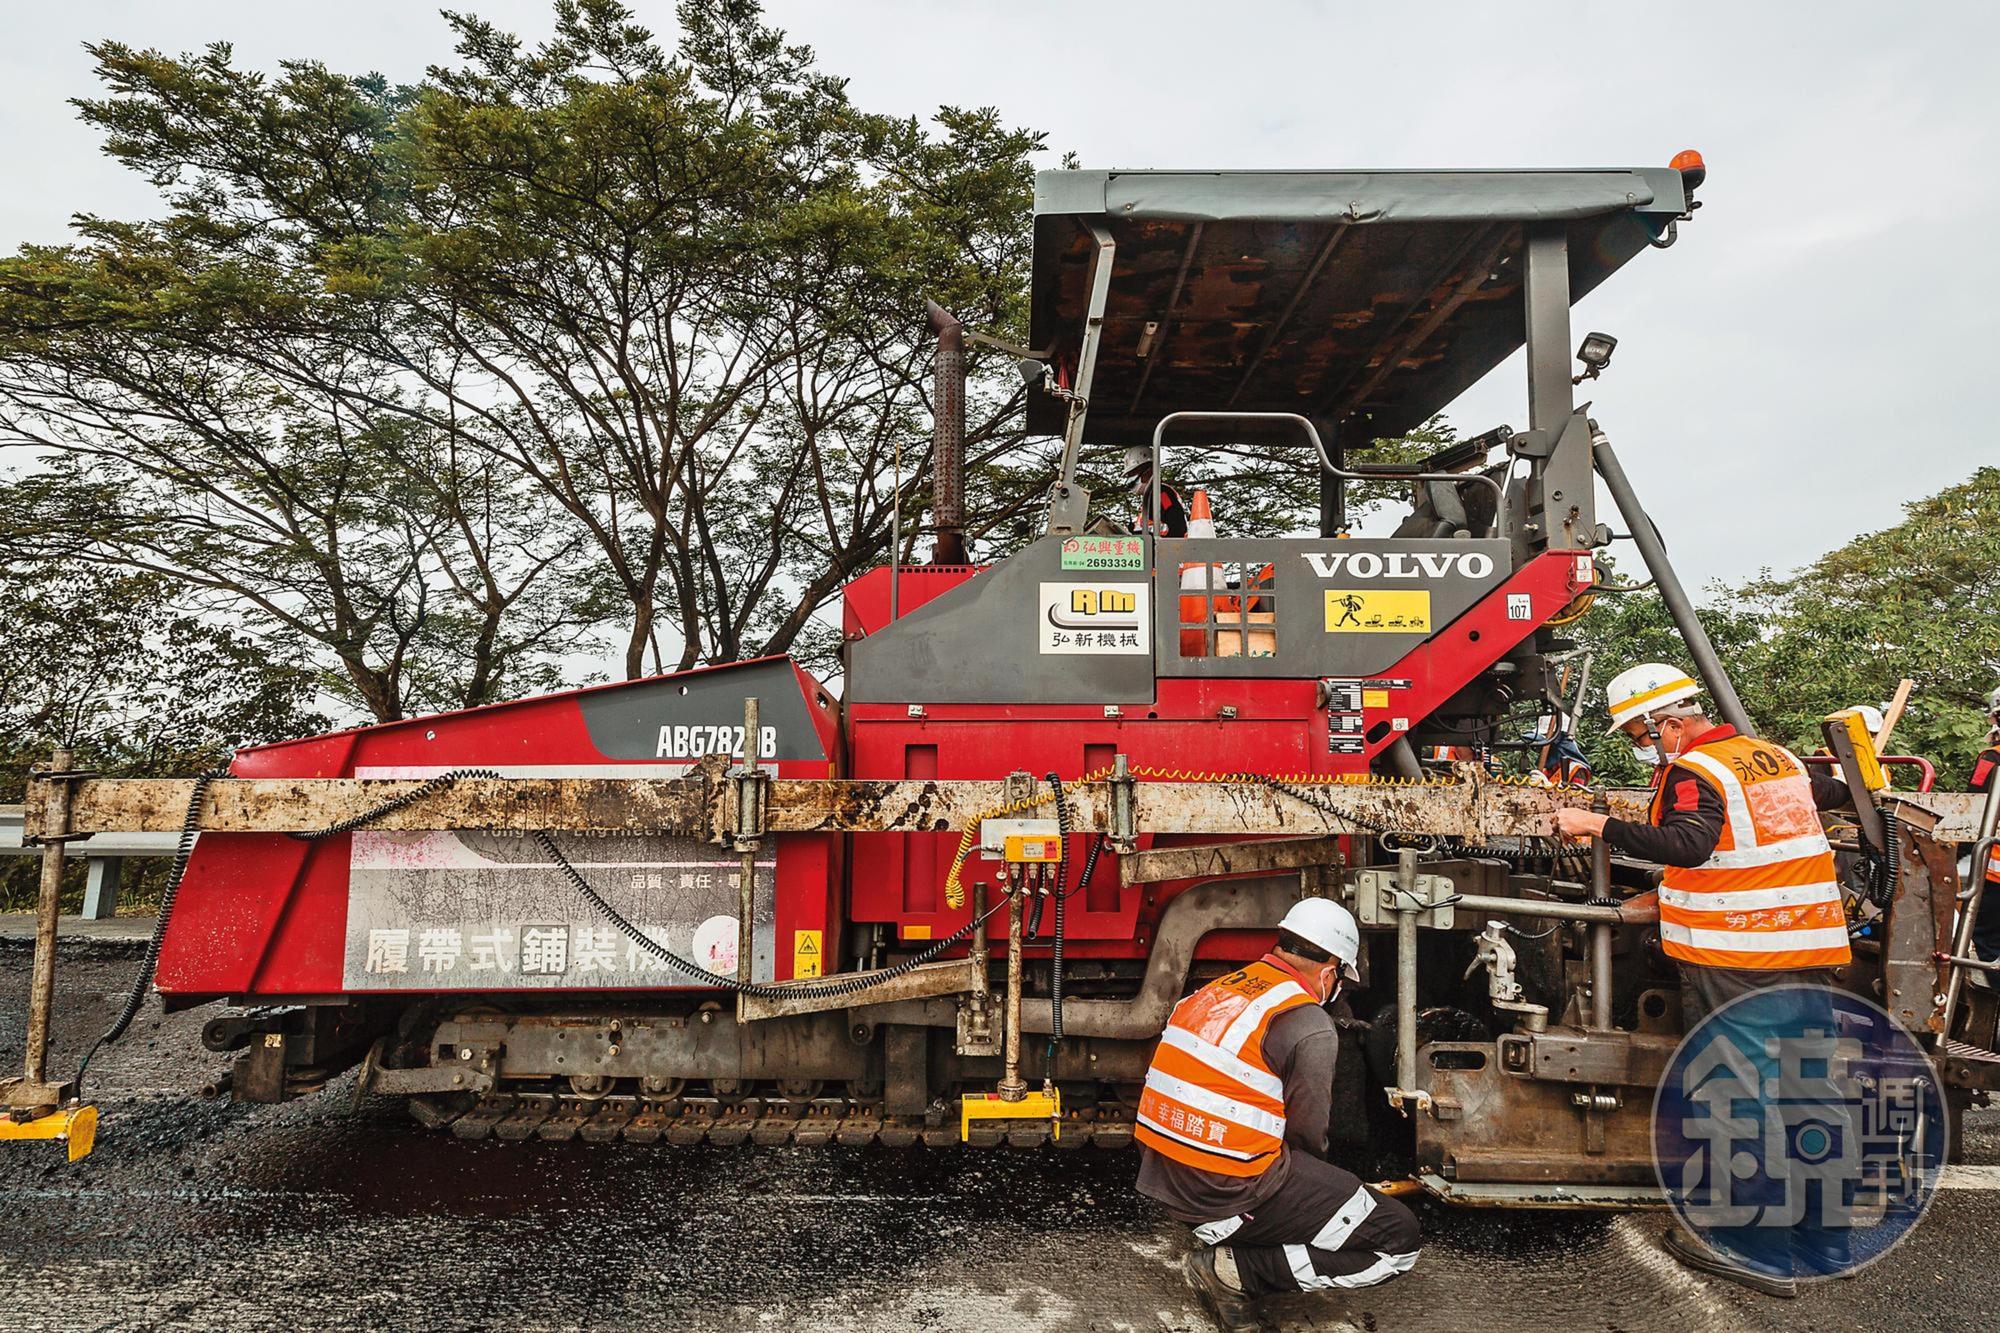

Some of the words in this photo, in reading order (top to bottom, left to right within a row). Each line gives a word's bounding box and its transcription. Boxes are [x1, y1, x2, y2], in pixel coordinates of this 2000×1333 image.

[1087, 558, 1141, 568] 26933349
[1301, 552, 1494, 579] VOLVO
[1509, 605, 1527, 618] 107
[1052, 632, 1139, 647] 弘新機械
[656, 725, 777, 758] ABG782B
